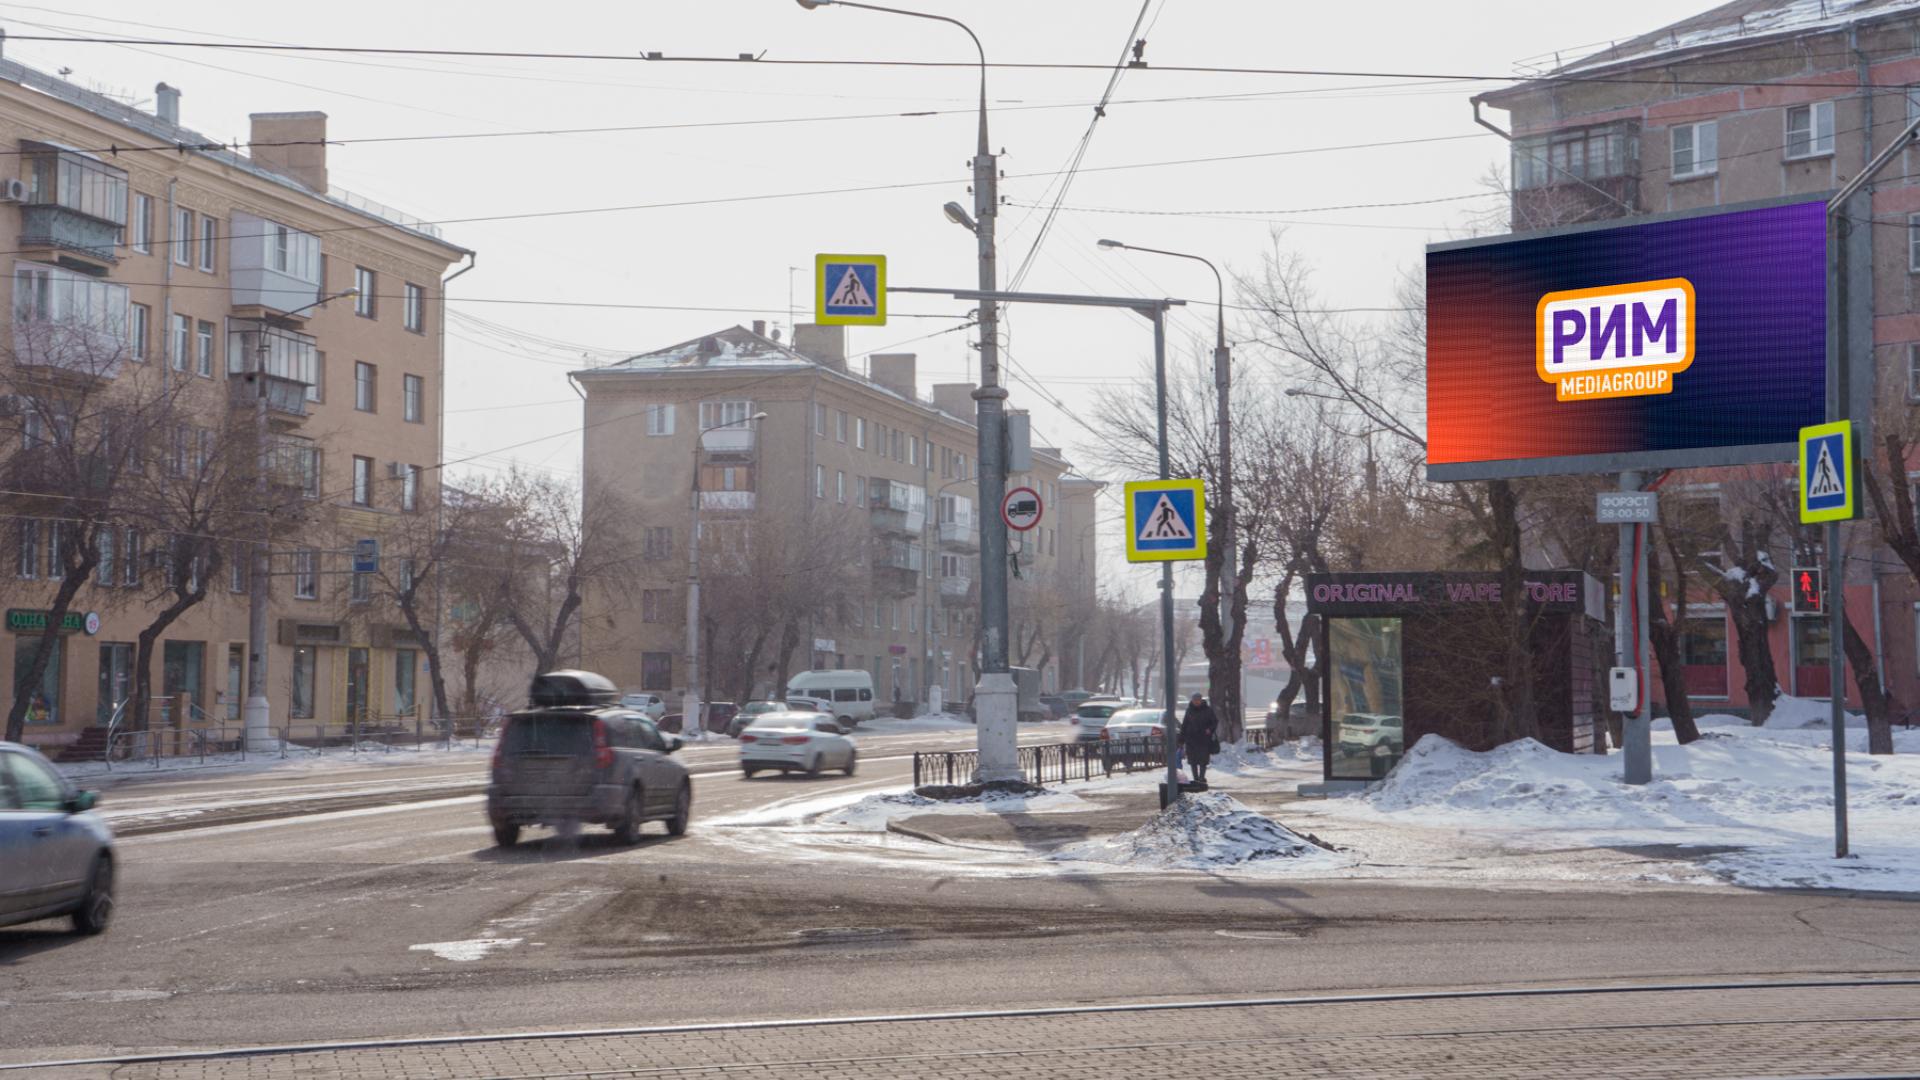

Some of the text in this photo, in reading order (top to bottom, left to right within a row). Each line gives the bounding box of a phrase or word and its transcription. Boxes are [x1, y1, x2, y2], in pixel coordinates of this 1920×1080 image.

[1553, 298, 1677, 364] РИМ
[1561, 370, 1668, 396] MEDIAGROUP
[1601, 496, 1649, 507] ФОРЭСТ
[1601, 508, 1649, 518] 58-00-50
[1313, 583, 1419, 602] ORIGINAL
[1446, 583, 1502, 602] VAPE
